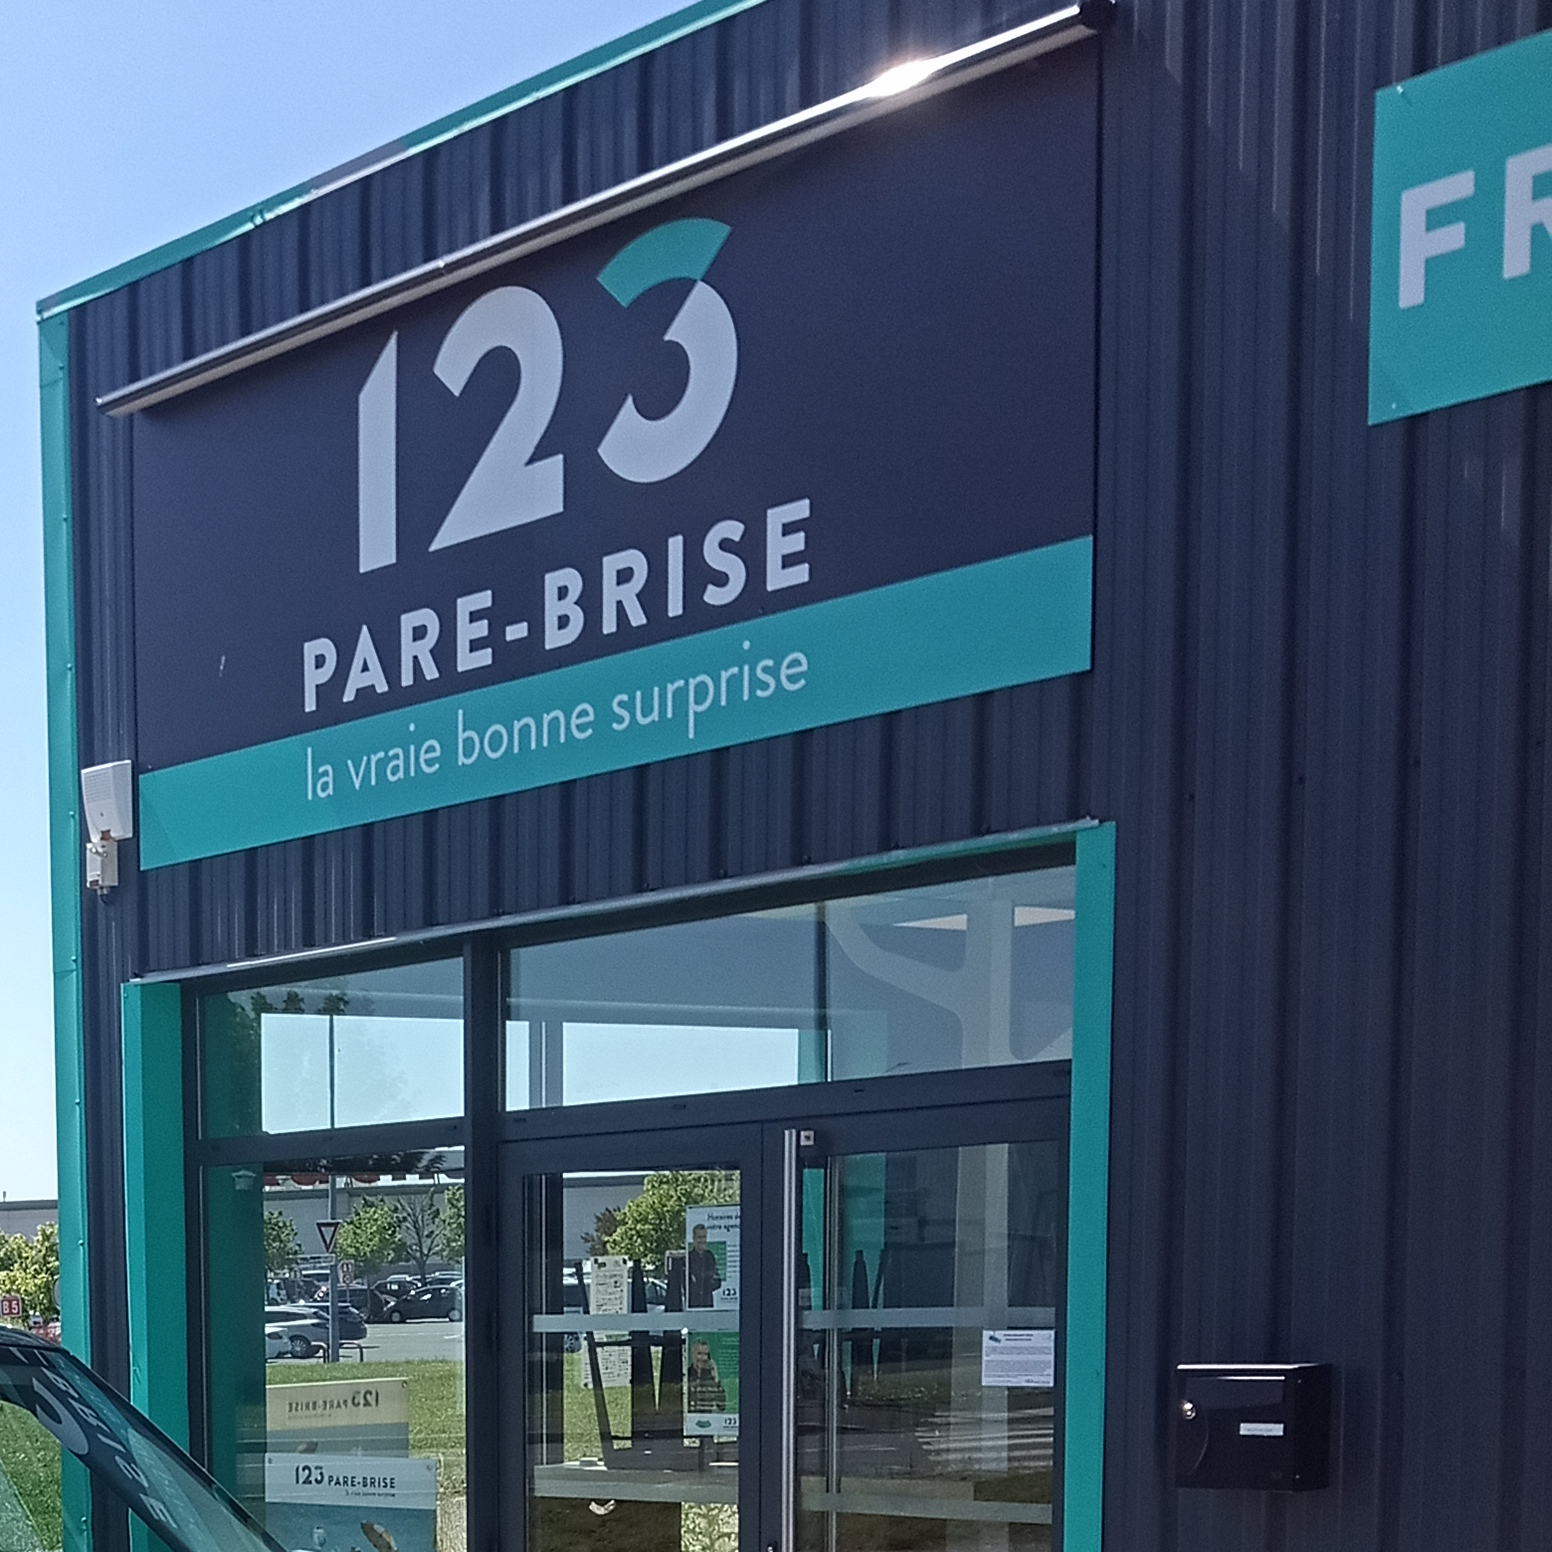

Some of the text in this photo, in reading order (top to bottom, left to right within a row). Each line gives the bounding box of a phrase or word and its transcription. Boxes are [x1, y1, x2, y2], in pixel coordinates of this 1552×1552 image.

[358, 217, 738, 573] 123
[303, 497, 811, 714] PARE-BRISE
[307, 639, 809, 800] la vraie bonne surprise
[295, 1464, 396, 1489] 123 PARE-BRISE
